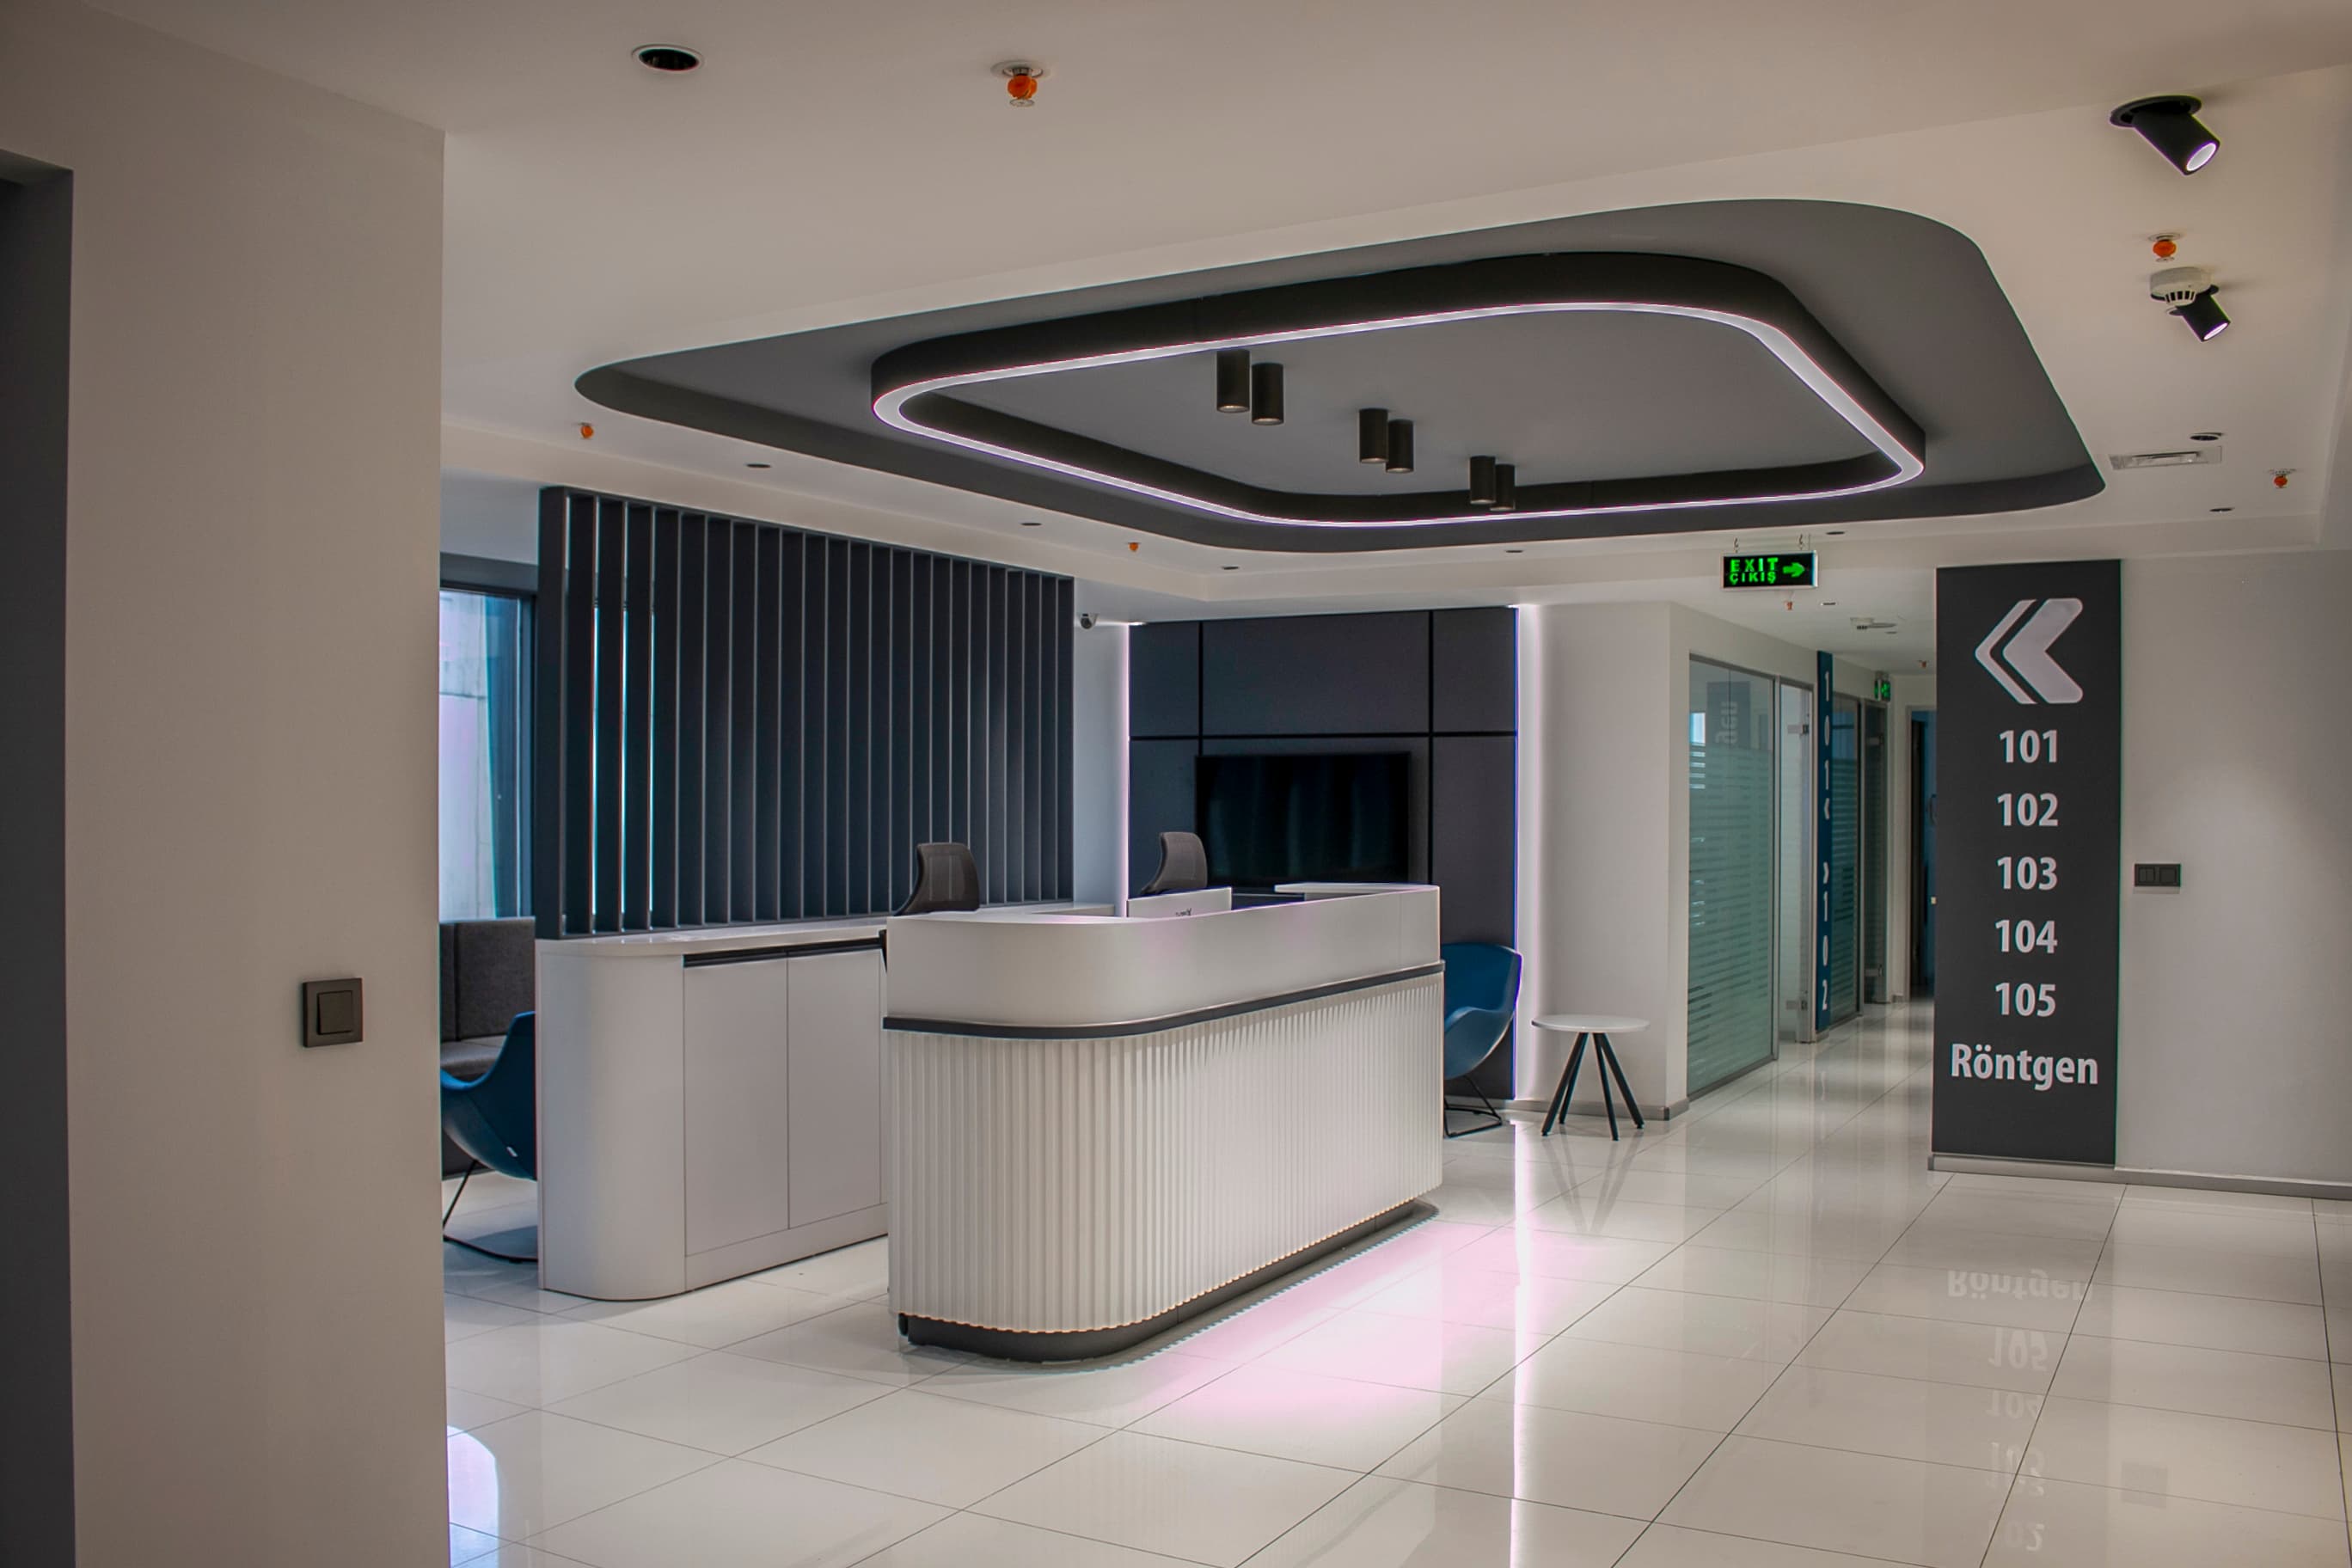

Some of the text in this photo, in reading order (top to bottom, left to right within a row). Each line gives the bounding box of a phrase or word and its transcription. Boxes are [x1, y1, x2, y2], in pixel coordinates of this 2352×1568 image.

[1730, 557, 1779, 573] EXIT
[1730, 571, 1776, 585] ÇIKIŞ
[2000, 730, 2058, 763] 101
[1997, 793, 2059, 826] 102
[1997, 856, 2058, 891] 103
[1995, 919, 2058, 954] 104
[1995, 982, 2056, 1017] 105
[1951, 1043, 2099, 1091] Röntgen
